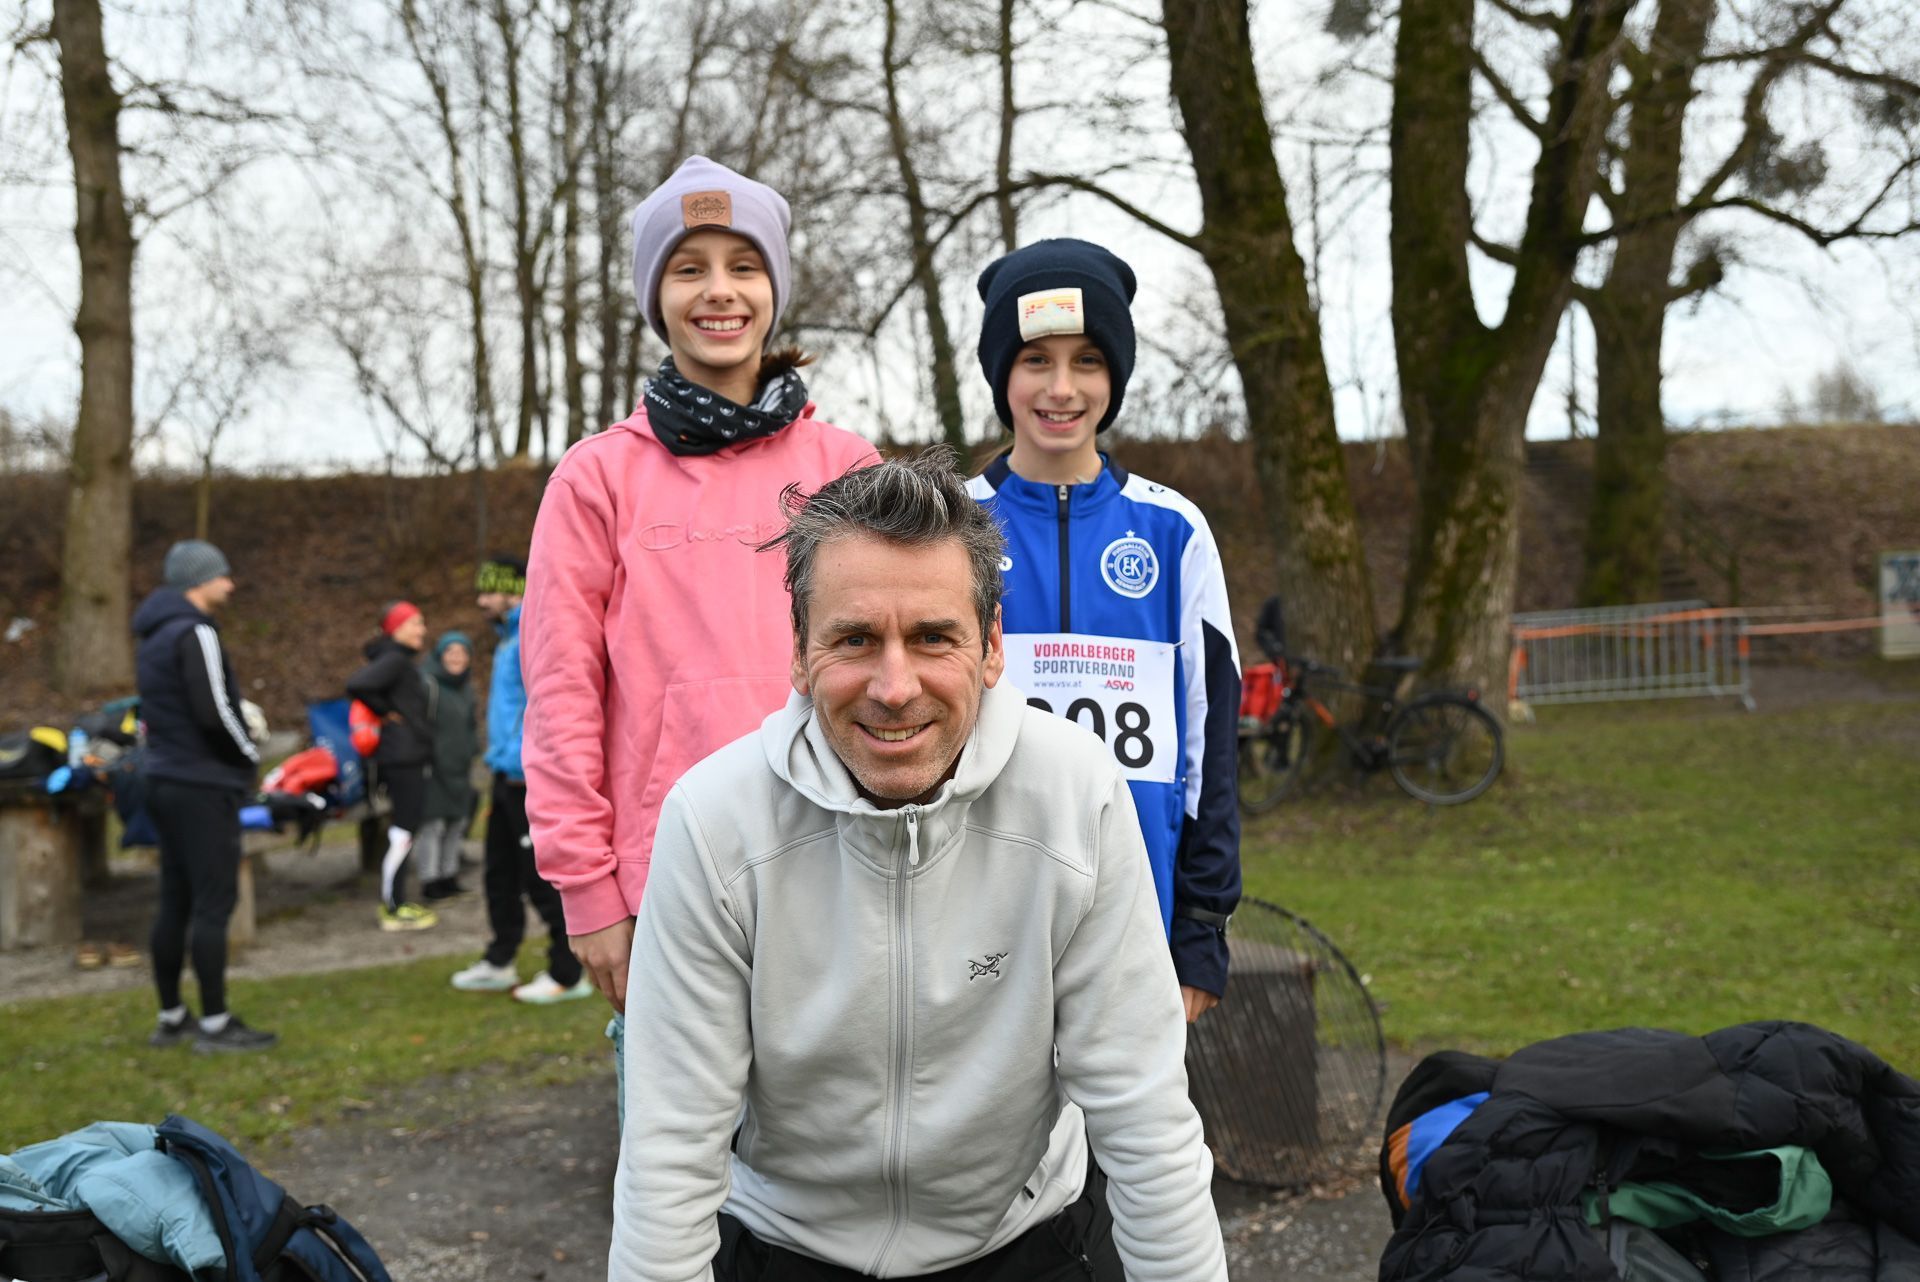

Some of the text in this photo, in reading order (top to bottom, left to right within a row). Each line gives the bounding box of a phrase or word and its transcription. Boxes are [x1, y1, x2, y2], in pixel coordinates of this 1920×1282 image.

[1034, 643, 1135, 662] VORARLBERGER
[1034, 660, 1135, 678] SPORTVERBAND
[1034, 680, 1082, 688] www.vsv.at
